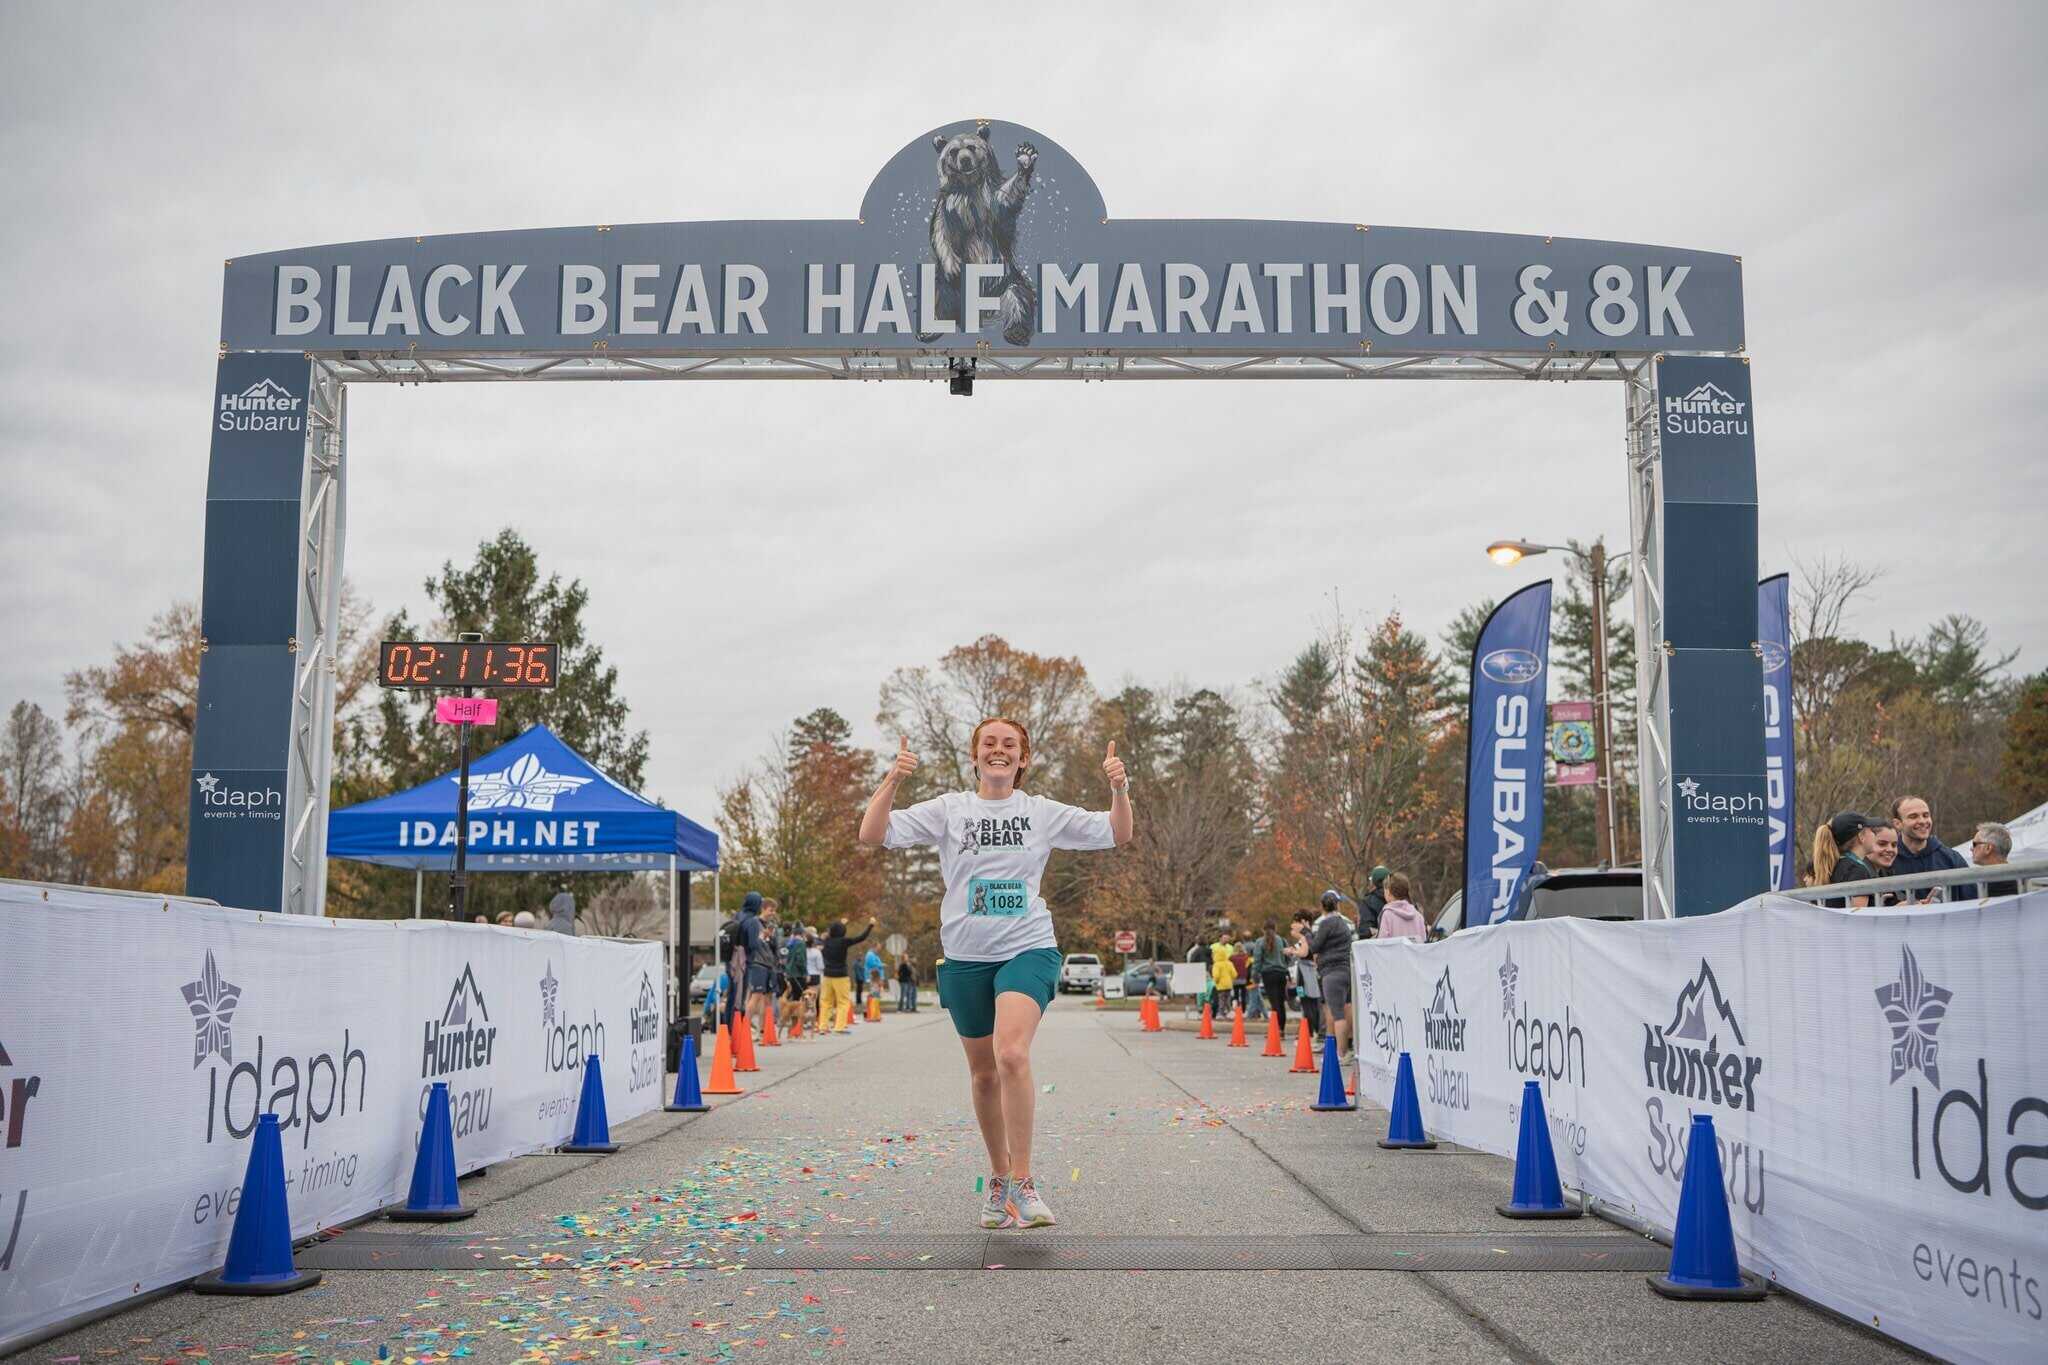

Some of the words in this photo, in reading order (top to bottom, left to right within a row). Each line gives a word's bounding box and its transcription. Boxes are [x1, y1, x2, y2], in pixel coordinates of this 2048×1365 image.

[272, 264, 528, 337] BLACK
[559, 263, 770, 336] BEAR
[804, 262, 1006, 335] HALF
[1038, 262, 1479, 336] MARATHON
[1512, 263, 1570, 338] &
[1588, 264, 1696, 338] 8K
[220, 393, 302, 411] Hunter
[1664, 396, 1746, 415] Hunter
[219, 411, 301, 431] Subaru
[1666, 414, 1748, 435] Subaru
[454, 703, 482, 717] Half
[204, 787, 281, 810] idaph
[204, 811, 237, 819] events
[248, 810, 281, 820] timing
[1687, 792, 1763, 815] idaph
[400, 821, 600, 846] IDAPH.NET
[981, 816, 1031, 831] BLACK
[981, 831, 1024, 846] BEAR
[1687, 815, 1720, 824] events
[1732, 815, 1764, 826] timing
[990, 895, 1023, 909] 1082
[630, 1007, 659, 1044] Hunter
[1423, 1007, 1466, 1052] Hunter
[422, 1017, 497, 1079] Hunter
[544, 1008, 606, 1081] idaph
[1508, 1000, 1586, 1098] idaph
[1427, 1054, 1470, 1112] Subaru
[1643, 1022, 1763, 1113] Hunter
[207, 1028, 366, 1150] idaph
[415, 1080, 493, 1153] Sbaru
[1549, 1105, 1586, 1156] iming
[301, 1152, 358, 1194] timing
[1645, 1096, 1766, 1216] Suru
[1913, 1242, 2043, 1321] events
